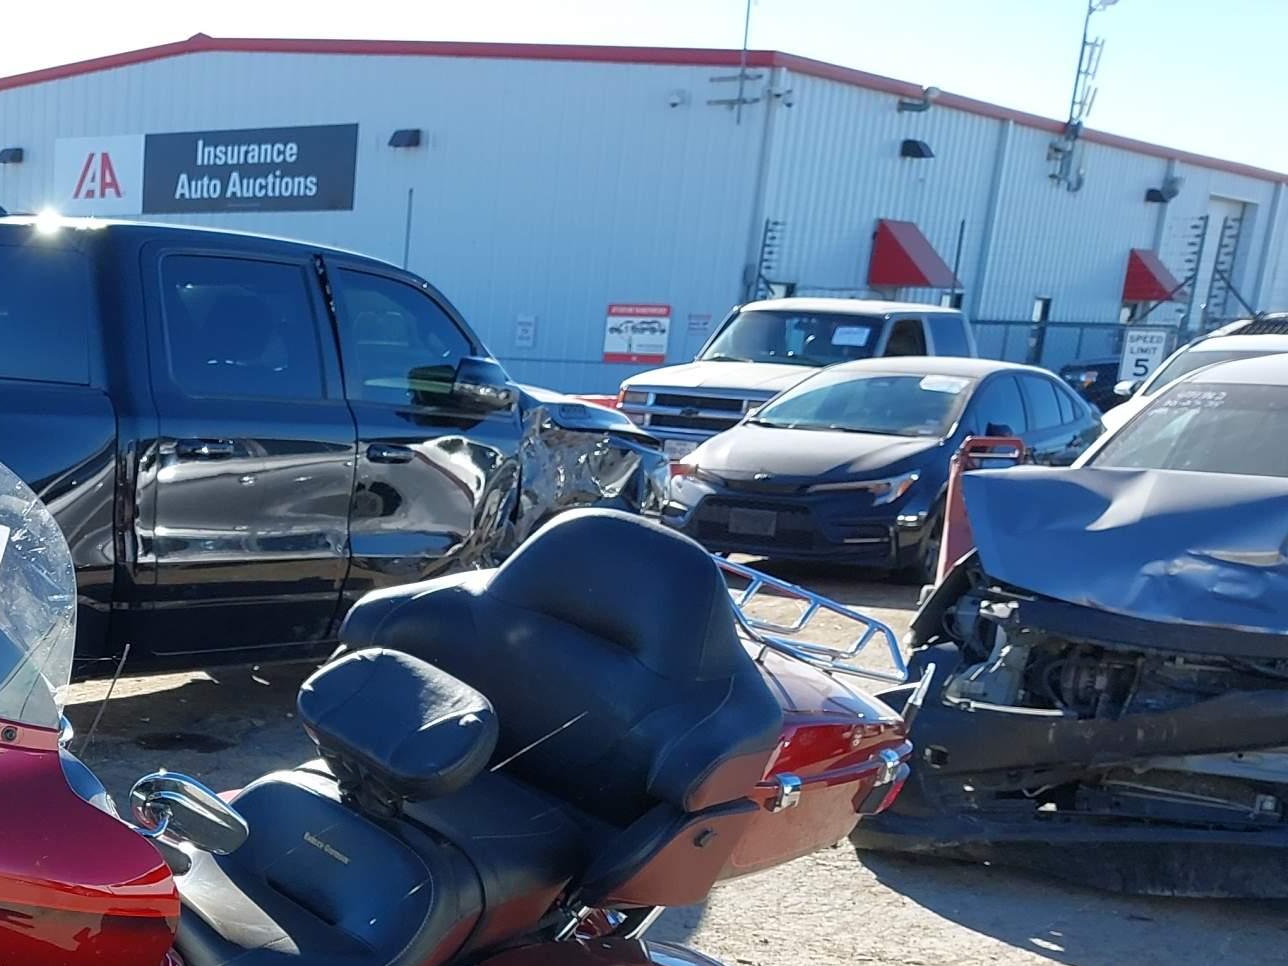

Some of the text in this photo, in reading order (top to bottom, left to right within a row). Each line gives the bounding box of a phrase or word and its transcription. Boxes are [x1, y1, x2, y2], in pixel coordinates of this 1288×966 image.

[196, 139, 298, 166] Insurance
[175, 170, 318, 200] Auto Auctions
[1129, 335, 1164, 344] SPEED
[1130, 346, 1157, 355] LIMIT
[1132, 358, 1149, 377] 5
